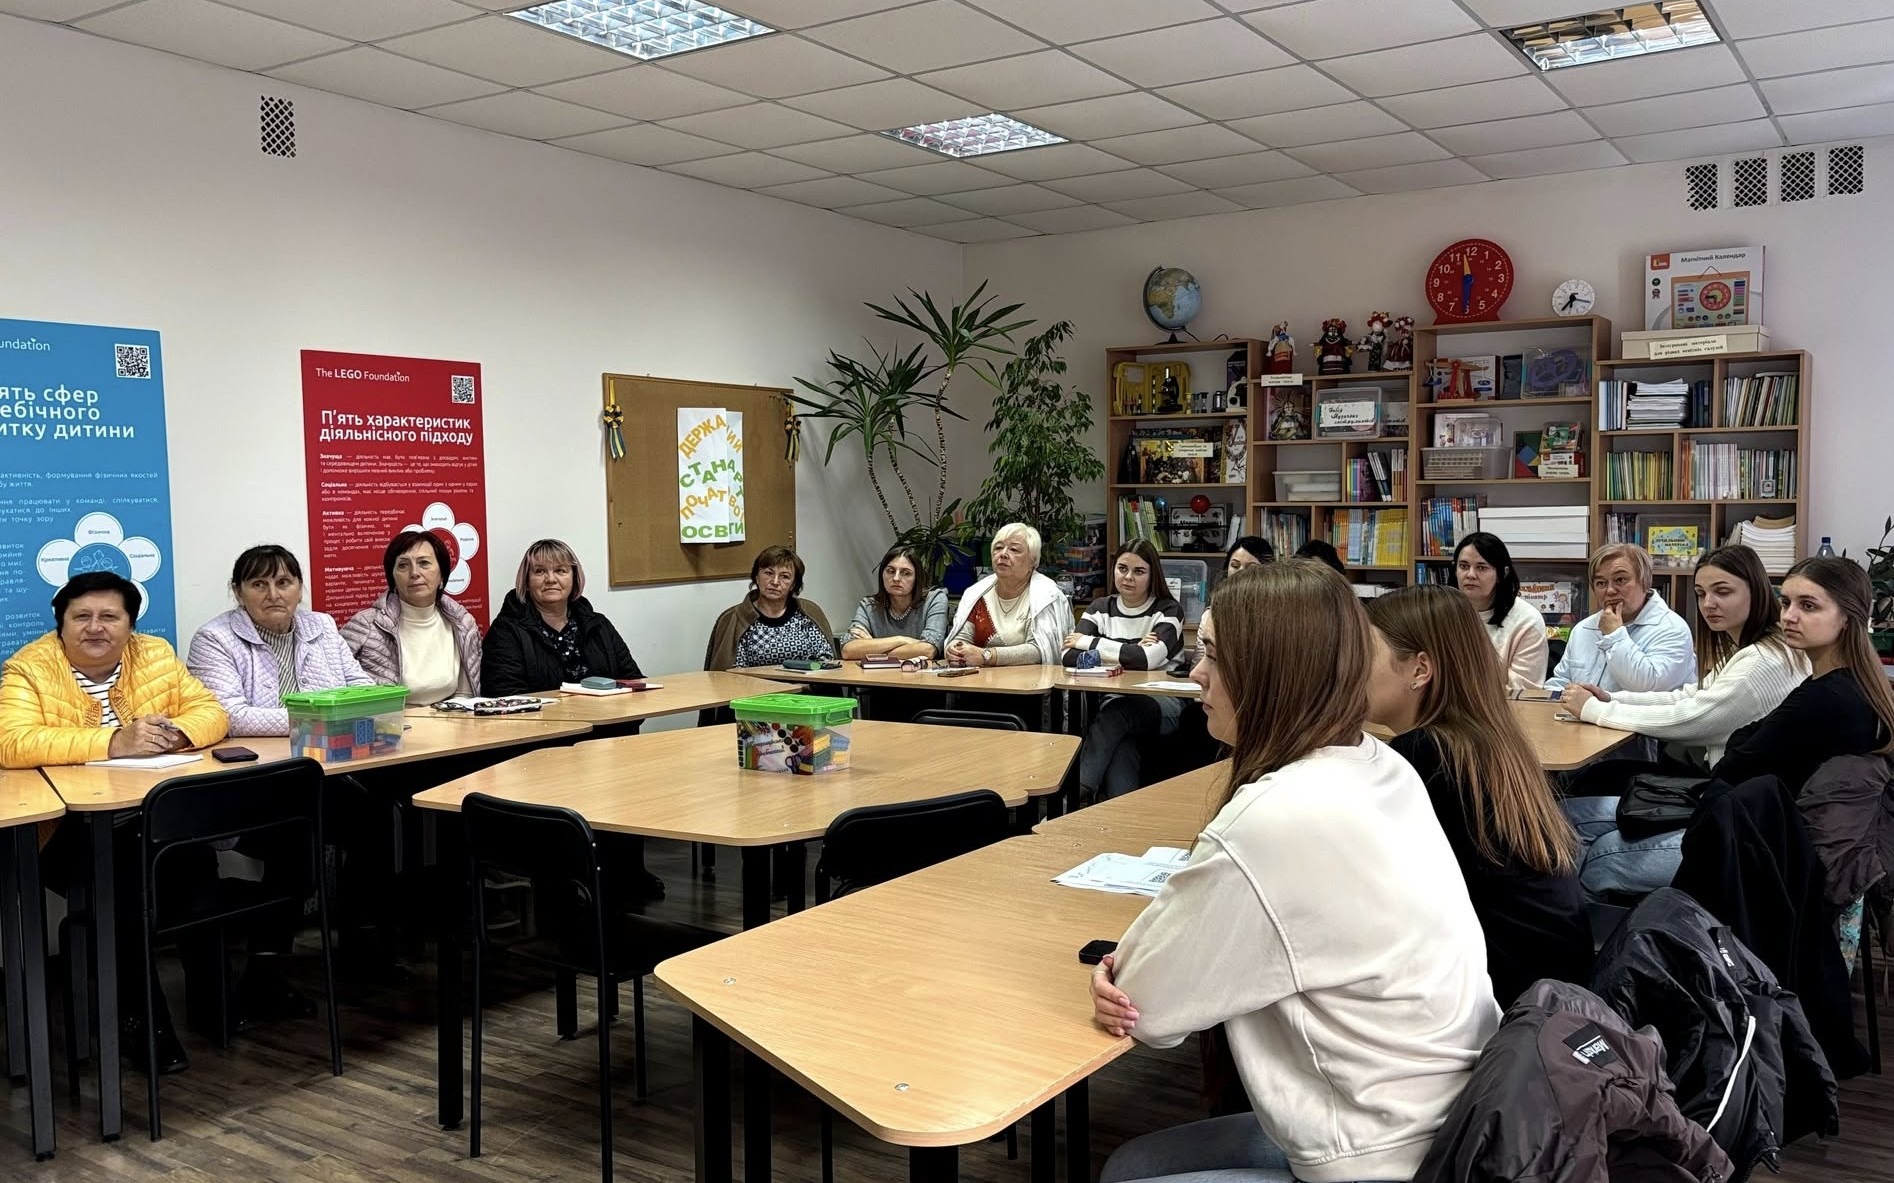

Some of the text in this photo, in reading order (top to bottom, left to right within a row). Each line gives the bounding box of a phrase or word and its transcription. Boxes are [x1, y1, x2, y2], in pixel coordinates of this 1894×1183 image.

[1466, 247, 1478, 256] 12
[1484, 251, 1489, 260] 1
[1450, 253, 1460, 262] 11
[1681, 252, 1746, 263] Магнітний Календар
[1438, 265, 1450, 274] 10
[1495, 261, 1502, 270] 2
[1433, 278, 1440, 287] 9
[1498, 274, 1505, 283] 3
[1437, 292, 1444, 302] 8
[1491, 289, 1498, 298] 4
[1449, 303, 1455, 312] 7
[1479, 301, 1486, 309] 5
[316, 368, 410, 382] The LEGO Foundation
[43, 384, 98, 406] сфер
[366, 415, 471, 430] характеристик
[54, 425, 135, 440] дитини
[319, 425, 474, 446] діяльнісного підходу
